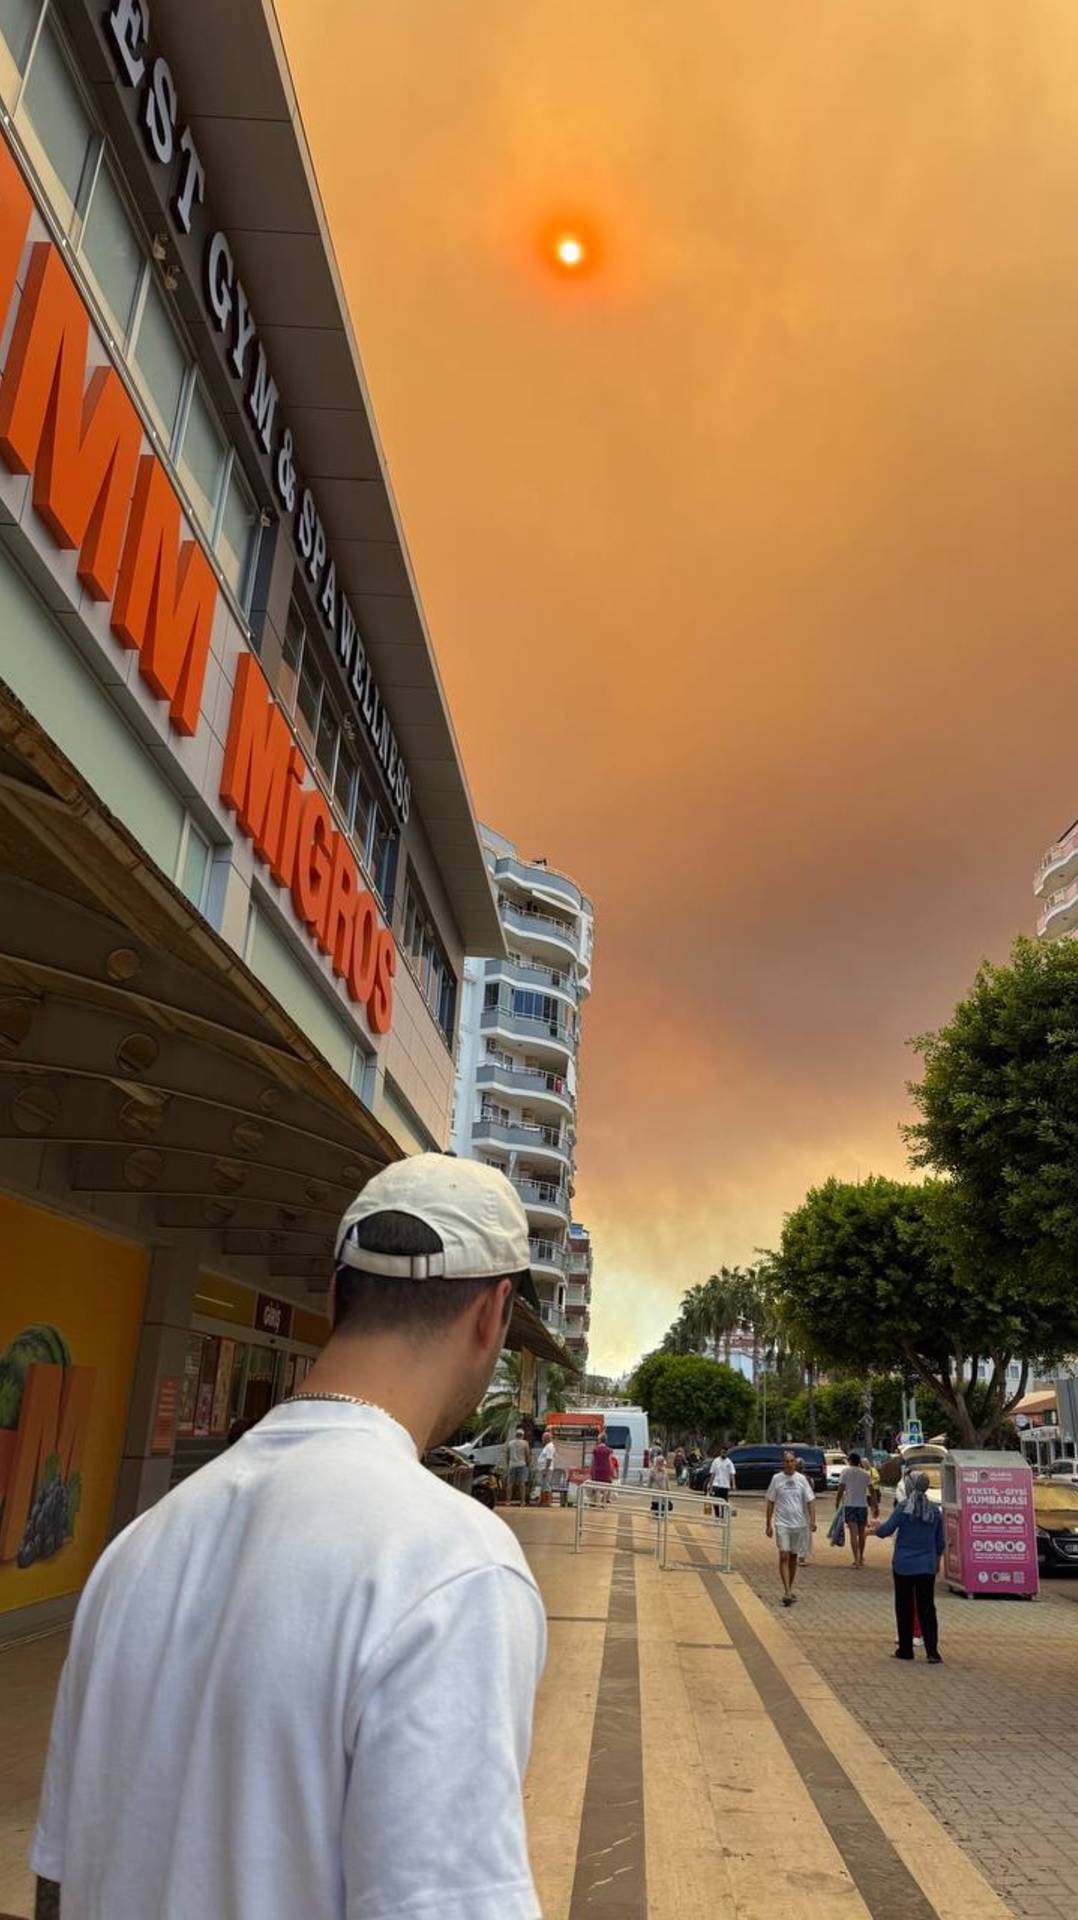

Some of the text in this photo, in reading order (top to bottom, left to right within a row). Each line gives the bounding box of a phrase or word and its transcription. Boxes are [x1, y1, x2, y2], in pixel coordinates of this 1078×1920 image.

[207, 230, 280, 456] GYM
[277, 427, 298, 514] &
[297, 487, 337, 630] SPA
[338, 589, 411, 825] WELLNESS
